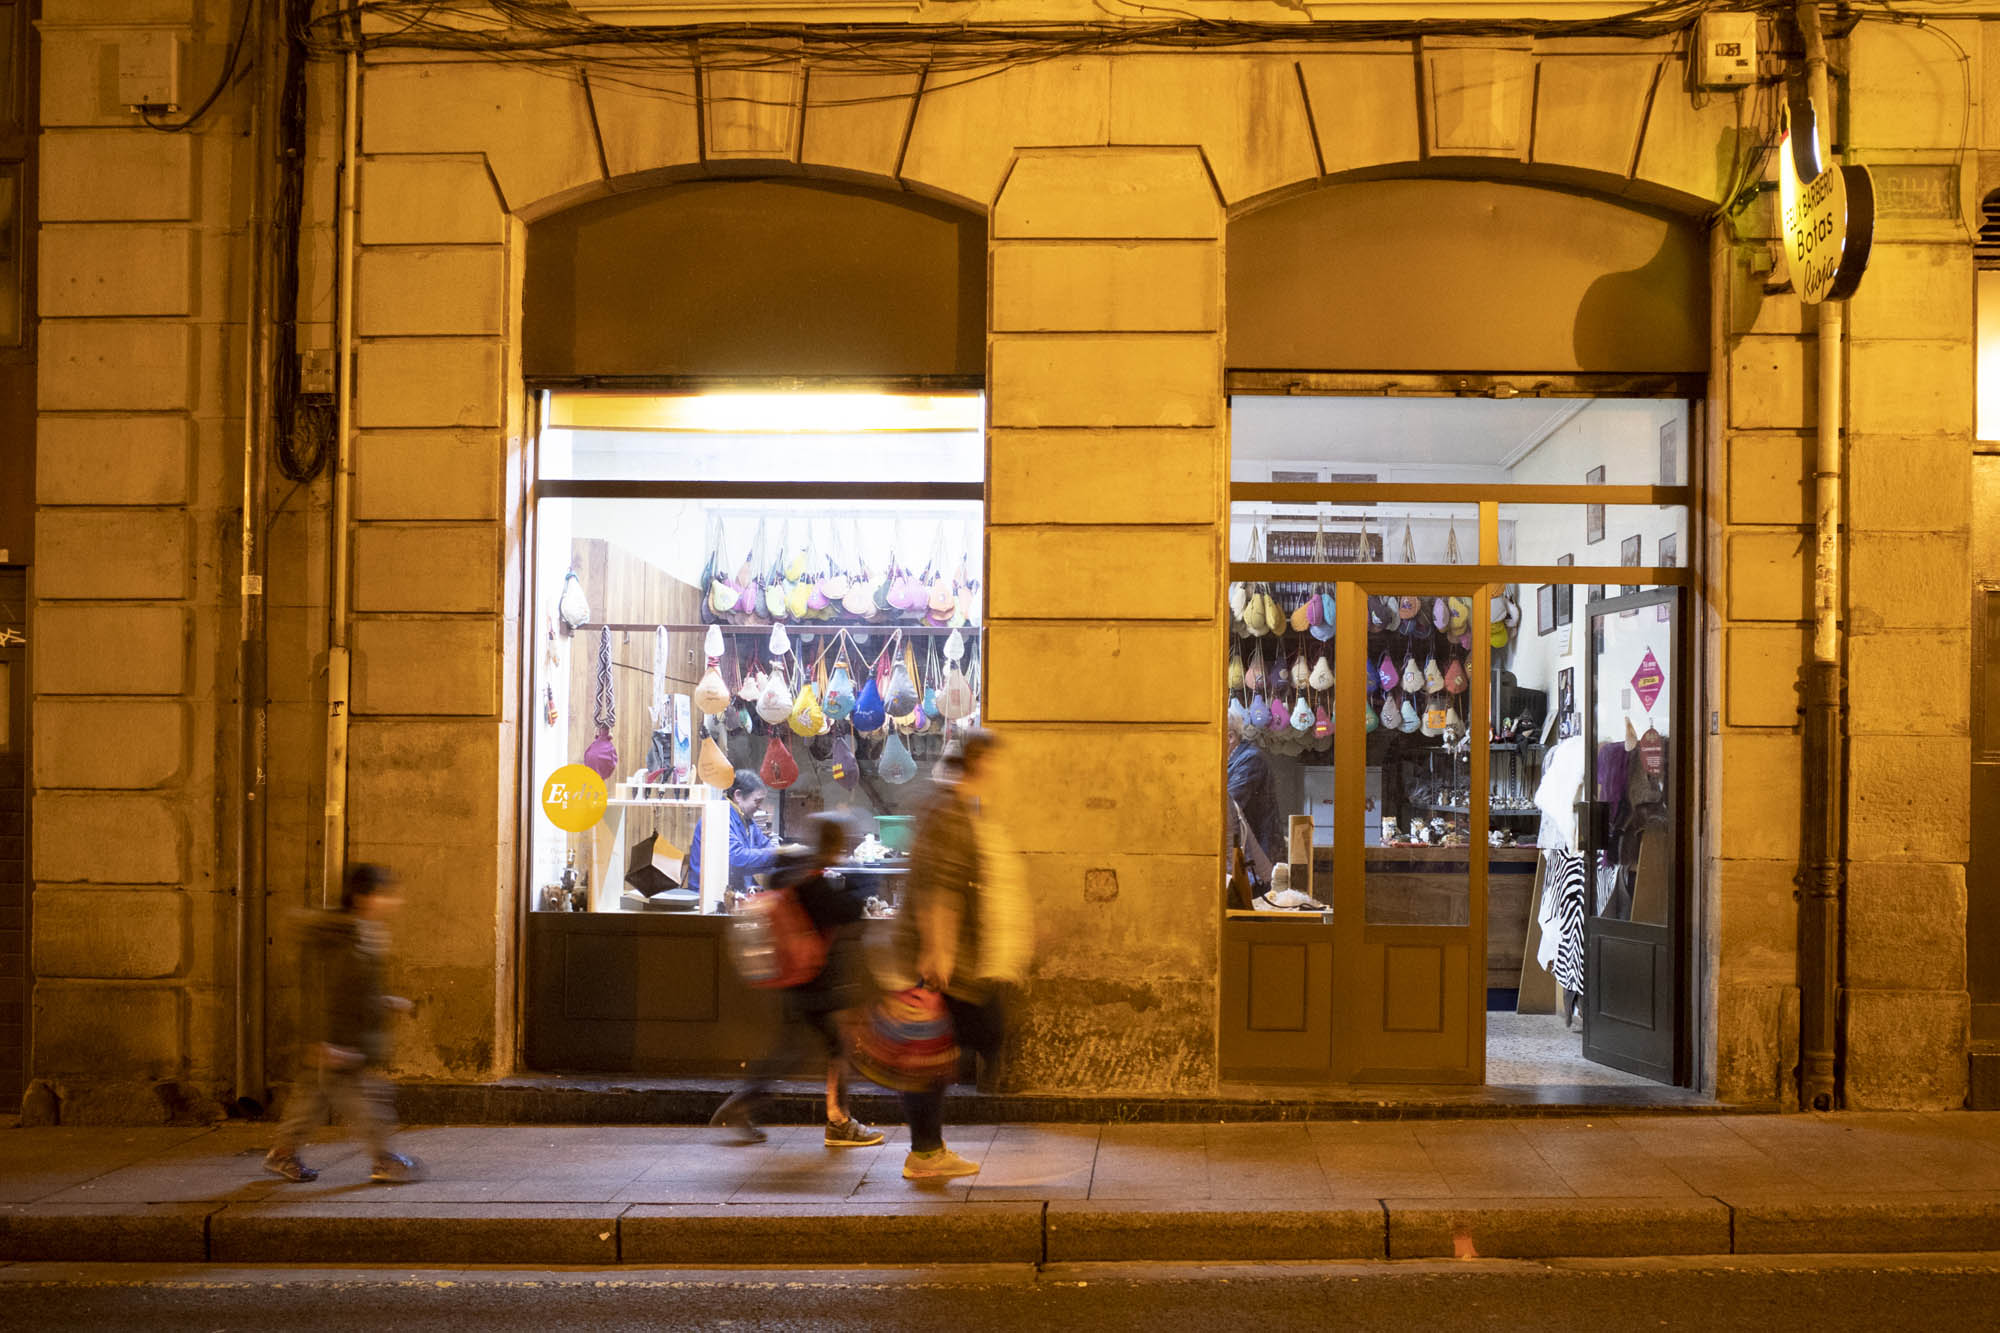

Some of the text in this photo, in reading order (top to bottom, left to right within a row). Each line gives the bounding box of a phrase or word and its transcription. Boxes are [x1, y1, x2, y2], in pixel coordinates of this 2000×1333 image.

[1802, 167, 1834, 218] BARBERO
[1797, 211, 1833, 261] Botas
[1803, 256, 1834, 301] Rioja
